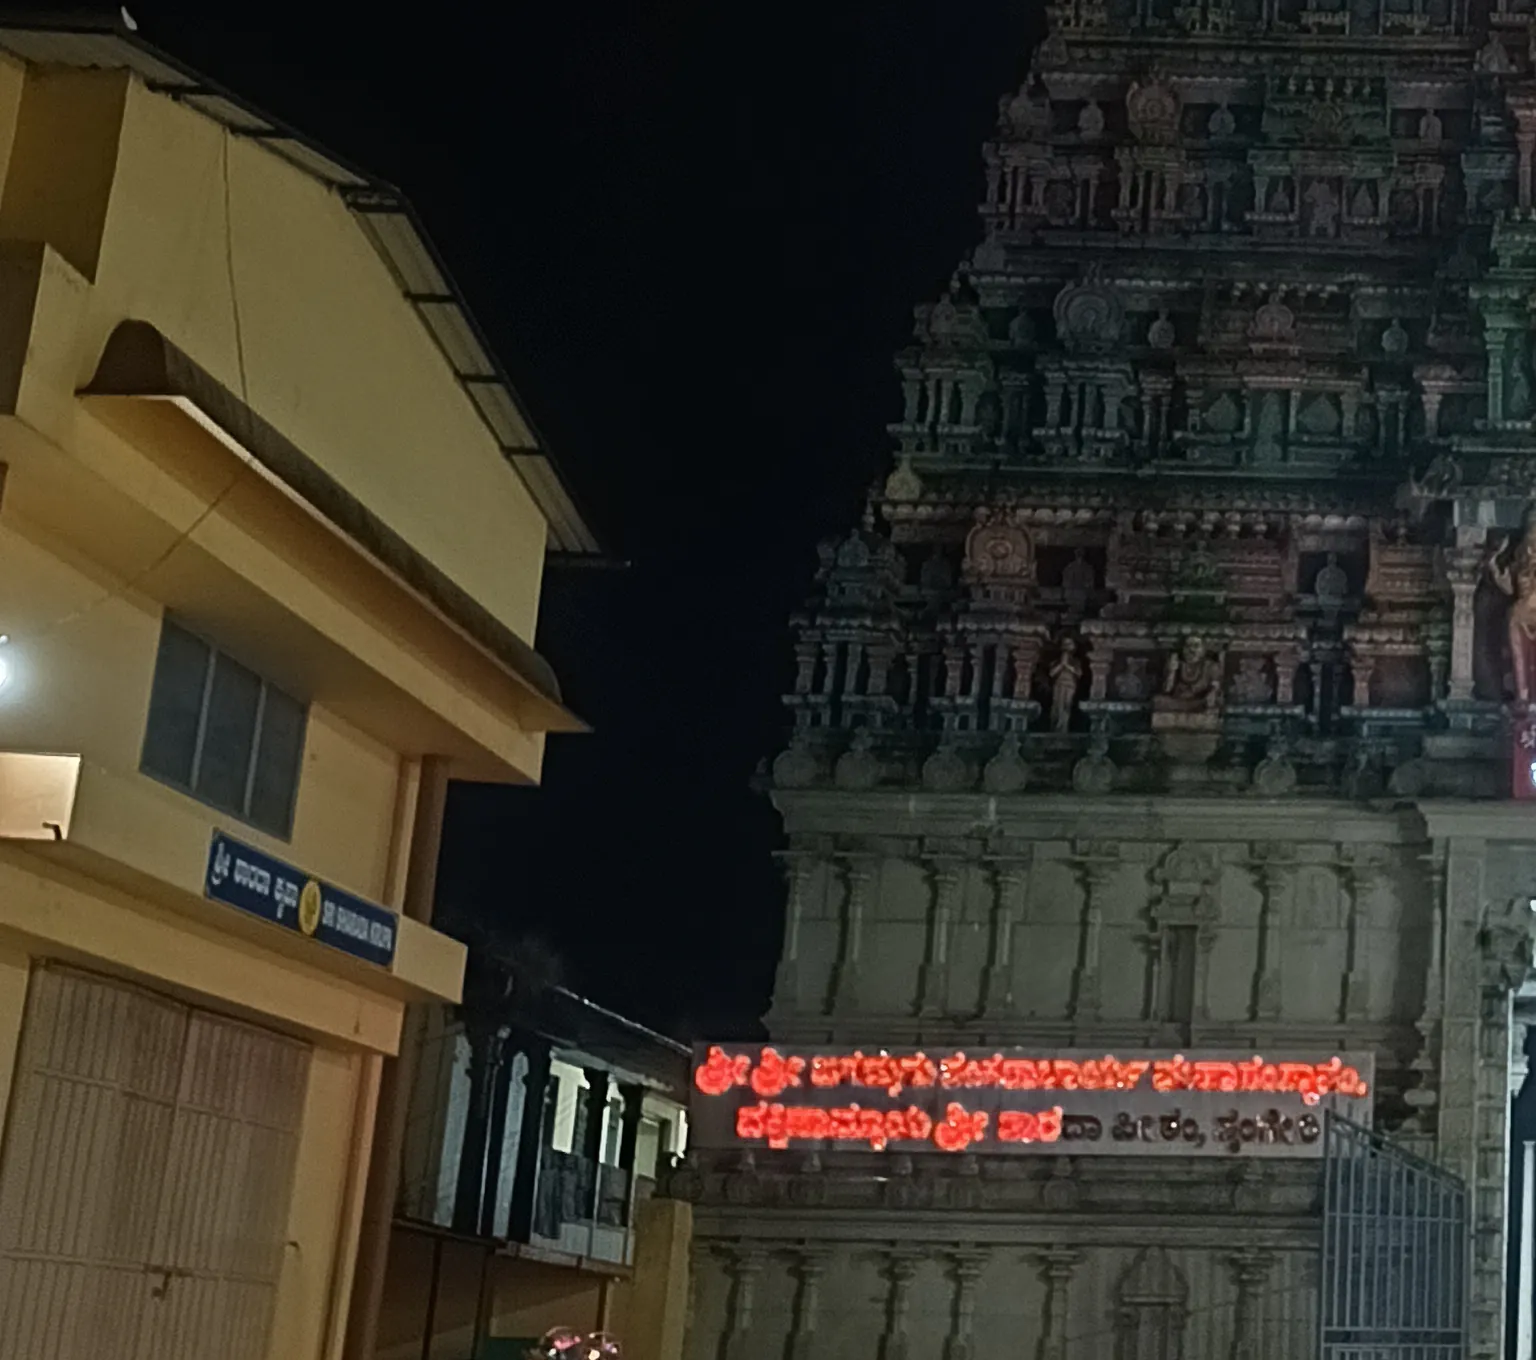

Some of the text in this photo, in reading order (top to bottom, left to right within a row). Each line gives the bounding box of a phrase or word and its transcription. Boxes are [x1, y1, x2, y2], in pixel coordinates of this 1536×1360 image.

[695, 1045, 751, 1095] ಶ್ರೀ
[751, 1045, 806, 1096] ಶ್ರೀ
[934, 1101, 989, 1151] ಶ್ರೀ
